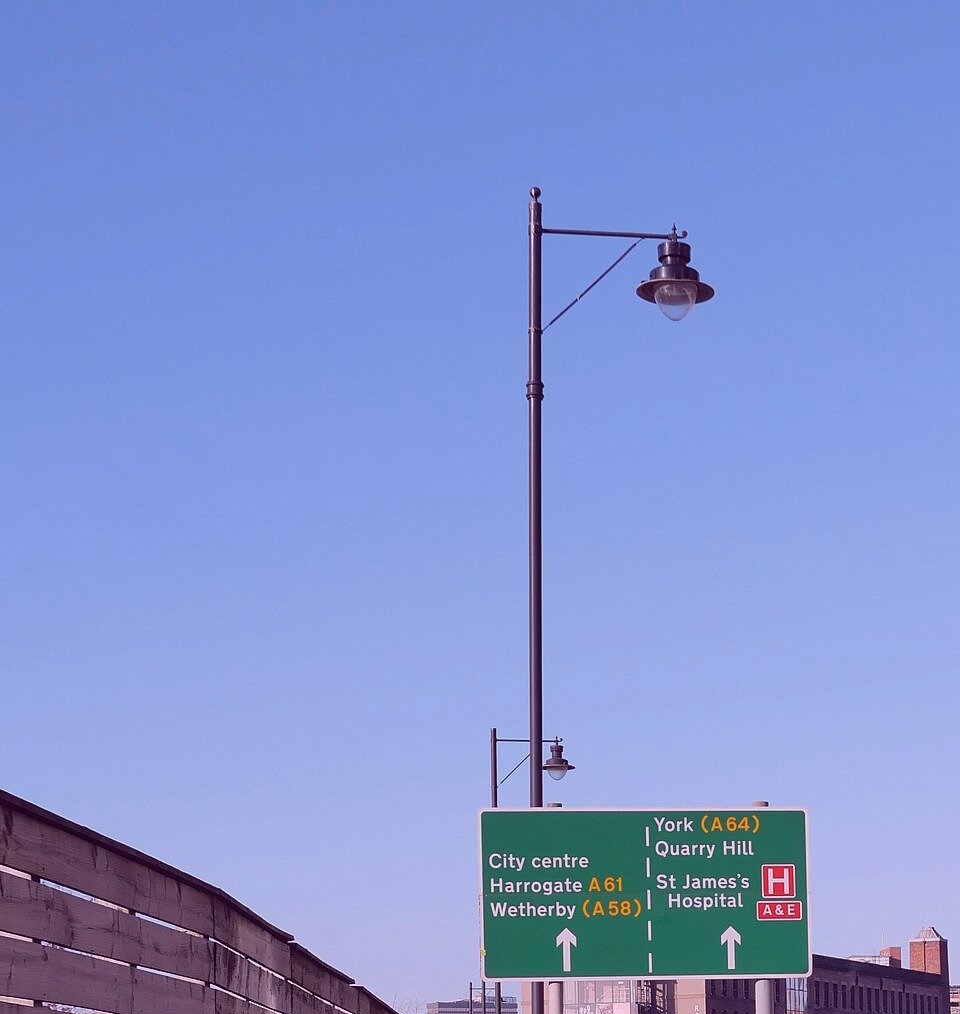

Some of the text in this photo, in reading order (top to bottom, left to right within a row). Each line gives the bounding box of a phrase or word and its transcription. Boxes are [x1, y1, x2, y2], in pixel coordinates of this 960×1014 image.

[653, 816, 694, 833] York
[654, 840, 754, 858] Quarry Hill
[488, 853, 589, 872] City centre
[490, 878, 583, 896] Harrogate
[656, 873, 750, 890] St James's
[767, 868, 790, 895] H
[667, 892, 744, 911] Hospital
[490, 902, 577, 920] Wetherby
